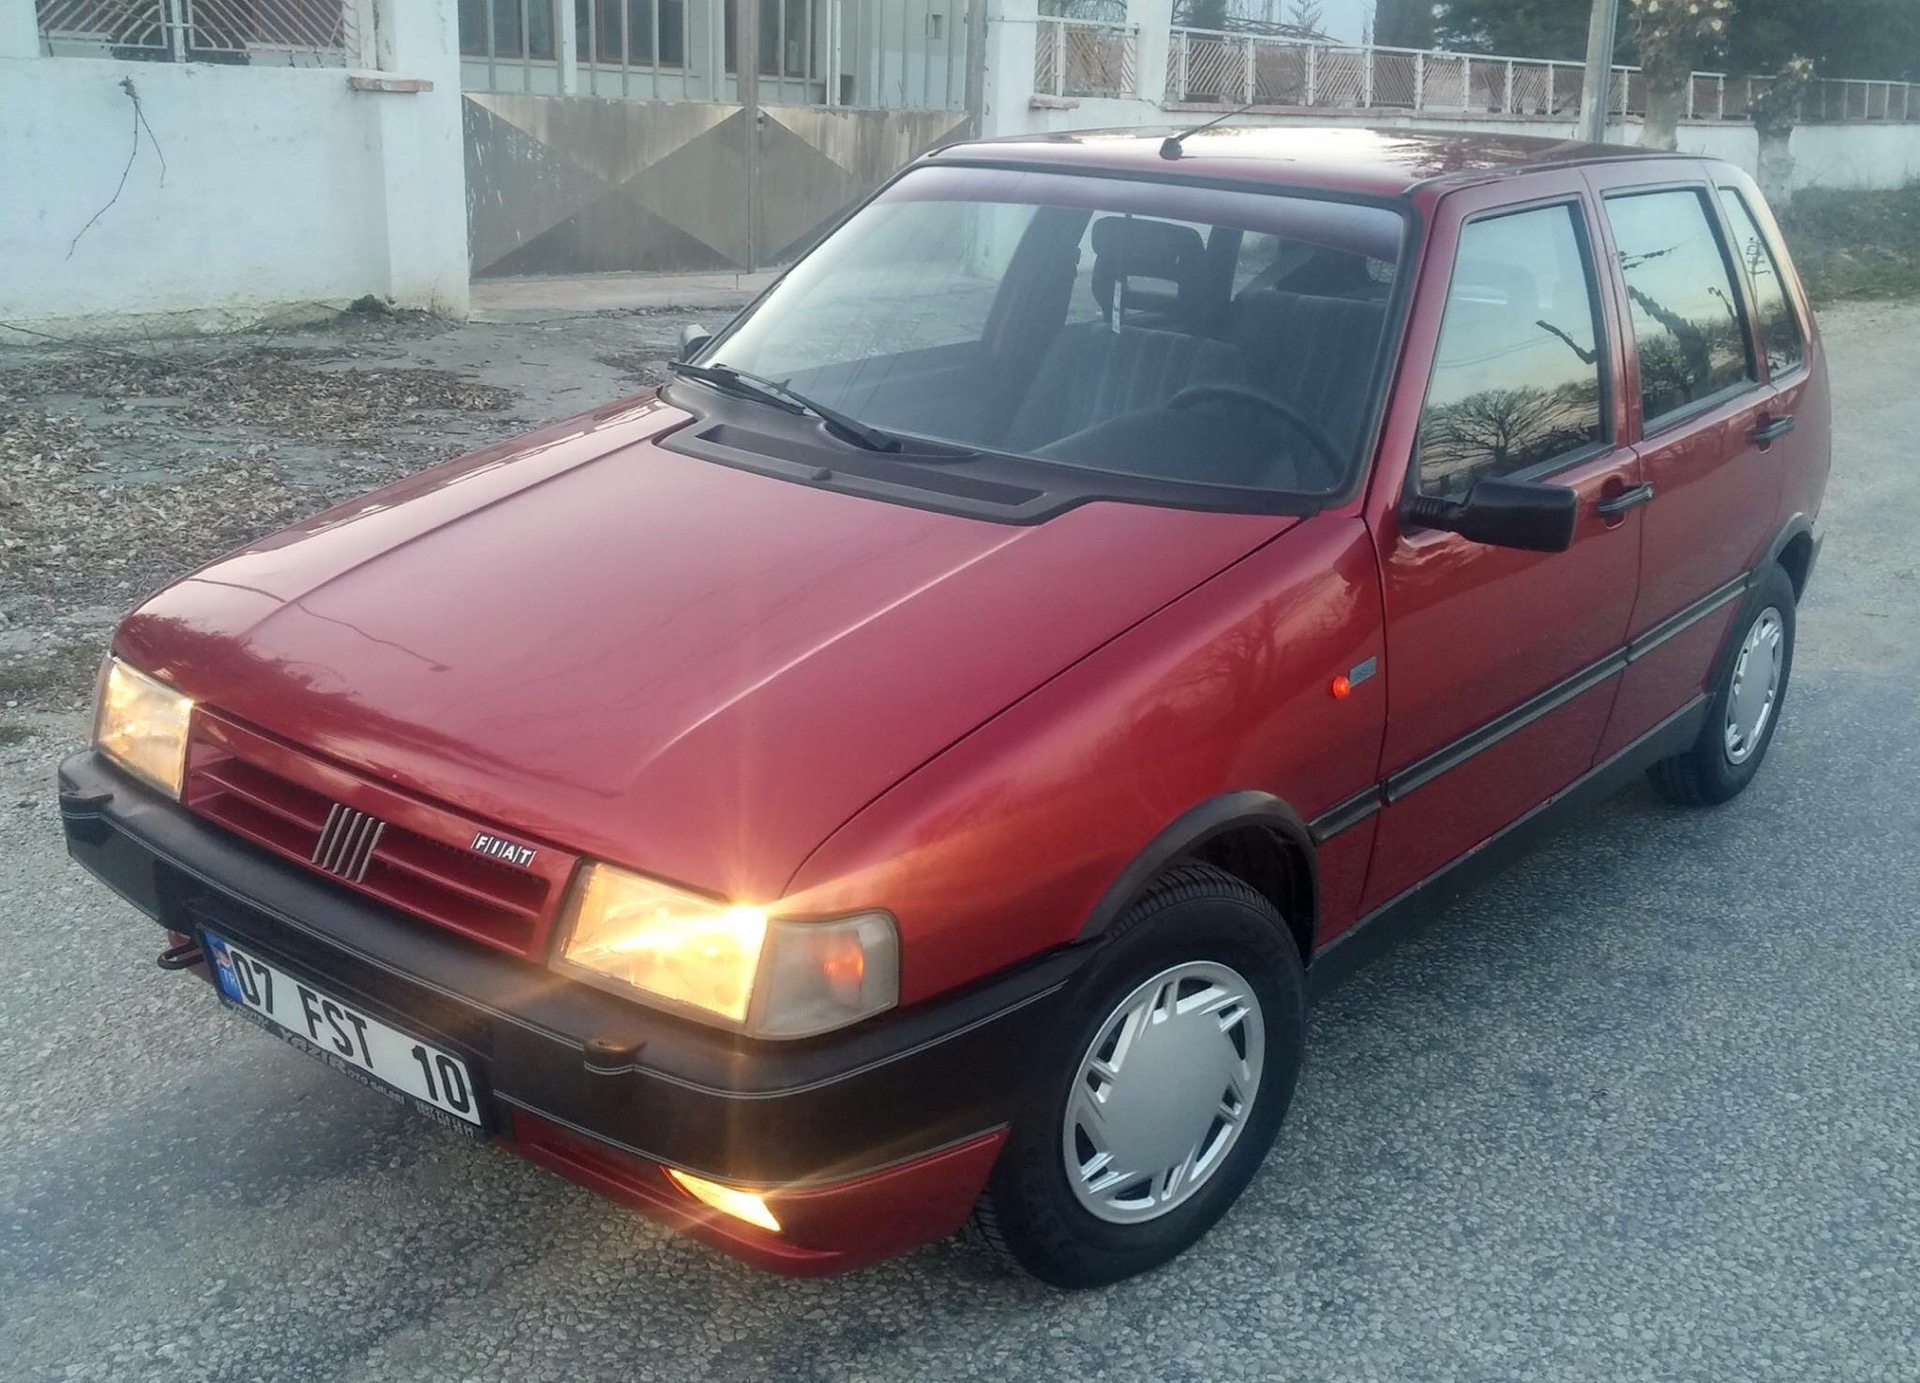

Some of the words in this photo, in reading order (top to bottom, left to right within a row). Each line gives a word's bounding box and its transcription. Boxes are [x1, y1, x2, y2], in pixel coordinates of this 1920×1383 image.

[473, 834, 535, 865] FIAT
[221, 968, 237, 989] TR
[231, 951, 273, 1014] 07
[297, 984, 374, 1068] FST
[411, 1045, 470, 1114] 10
